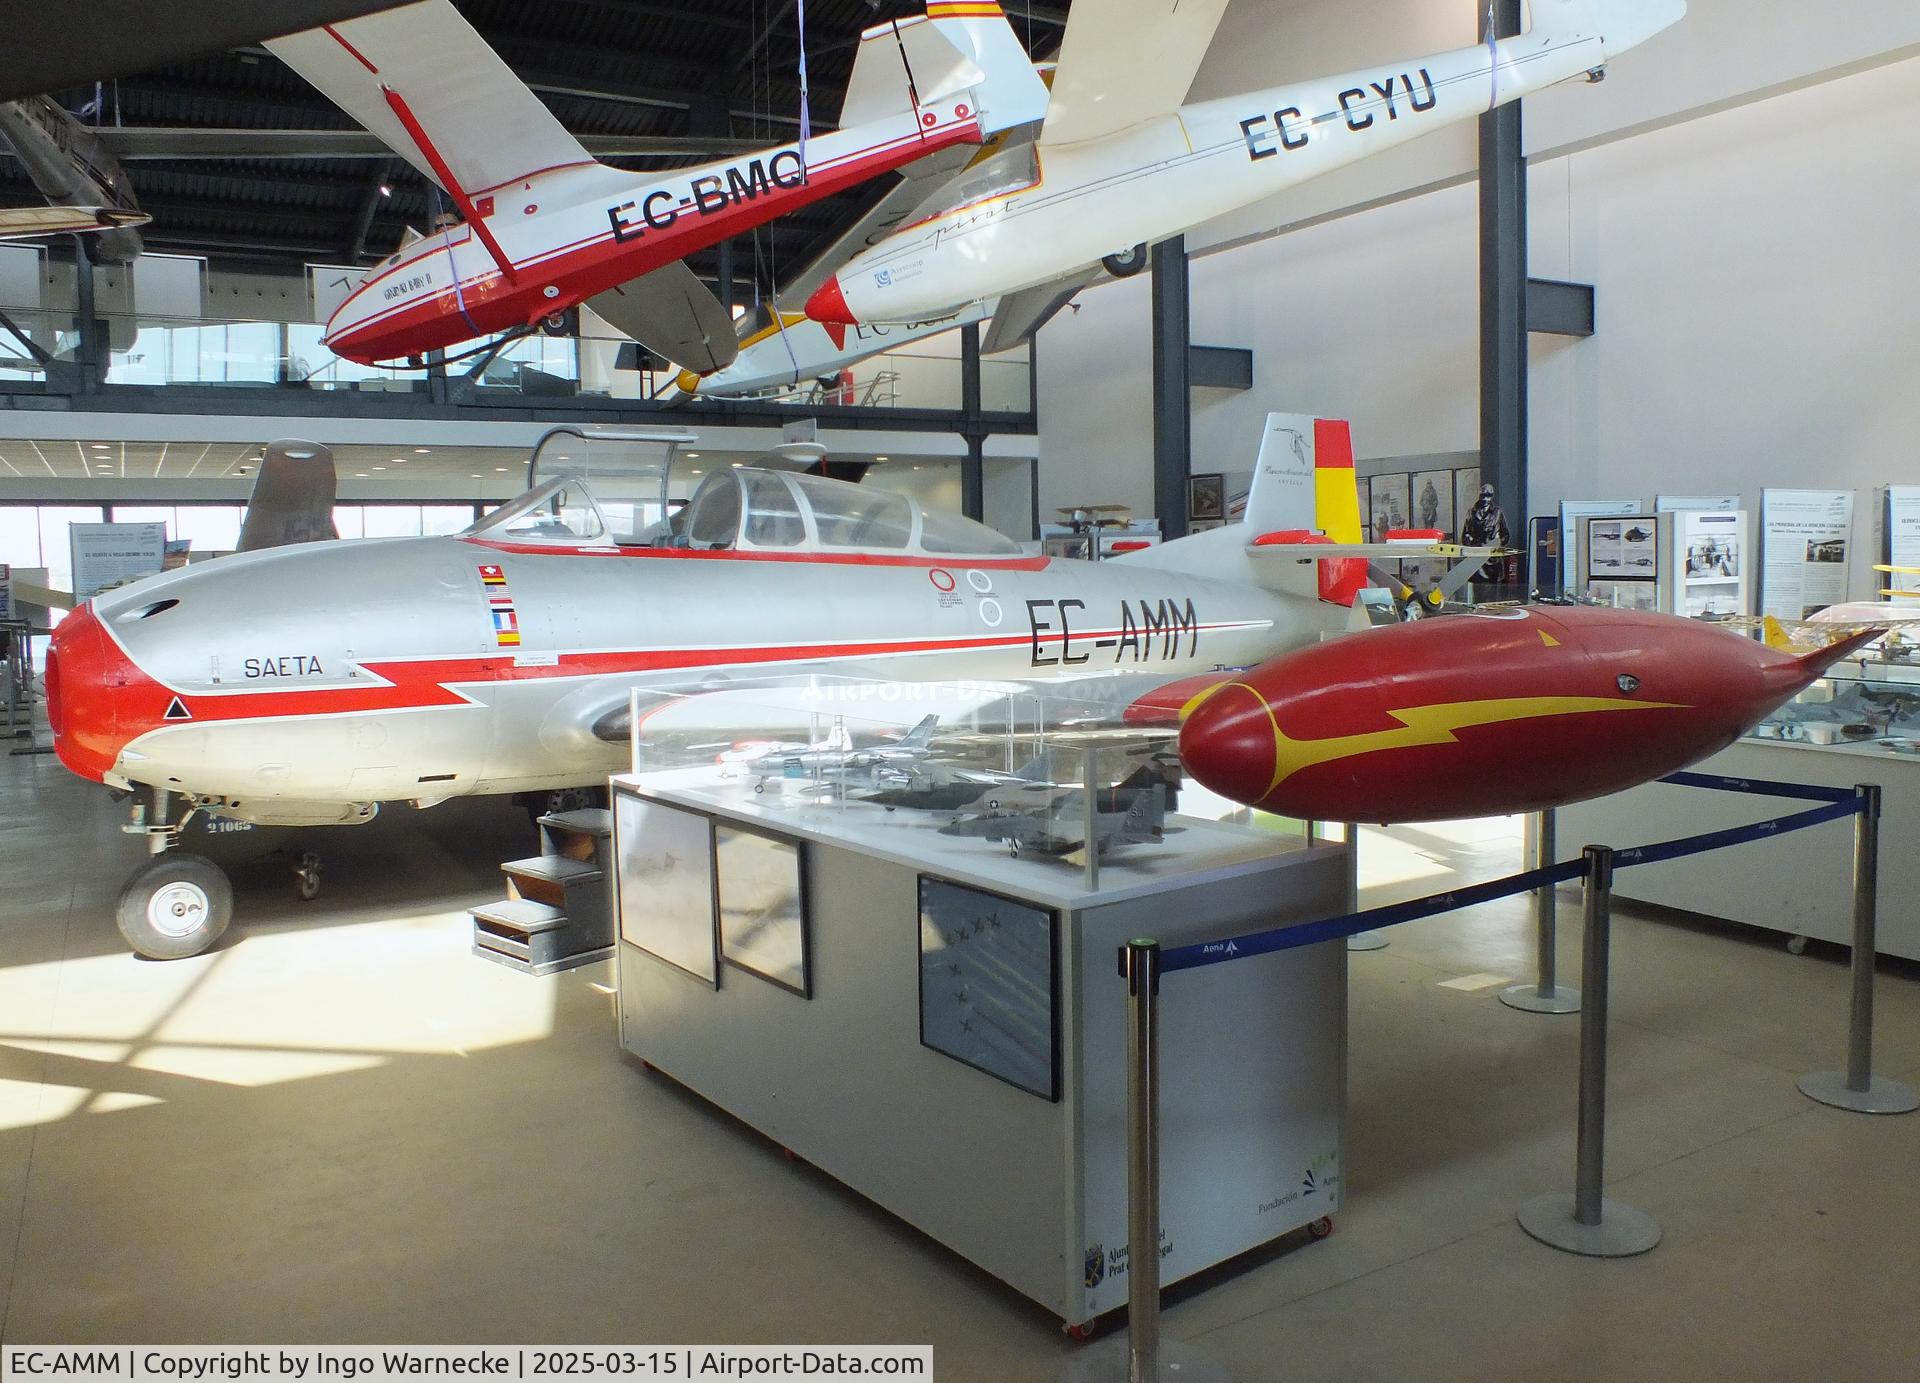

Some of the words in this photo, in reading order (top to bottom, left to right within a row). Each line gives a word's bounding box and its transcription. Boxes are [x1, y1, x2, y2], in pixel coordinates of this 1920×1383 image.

[1239, 69, 1436, 161] EC-CYU
[608, 150, 810, 244] EC-BMQ
[245, 655, 323, 679] SAETA
[1203, 944, 1224, 953] Aena
